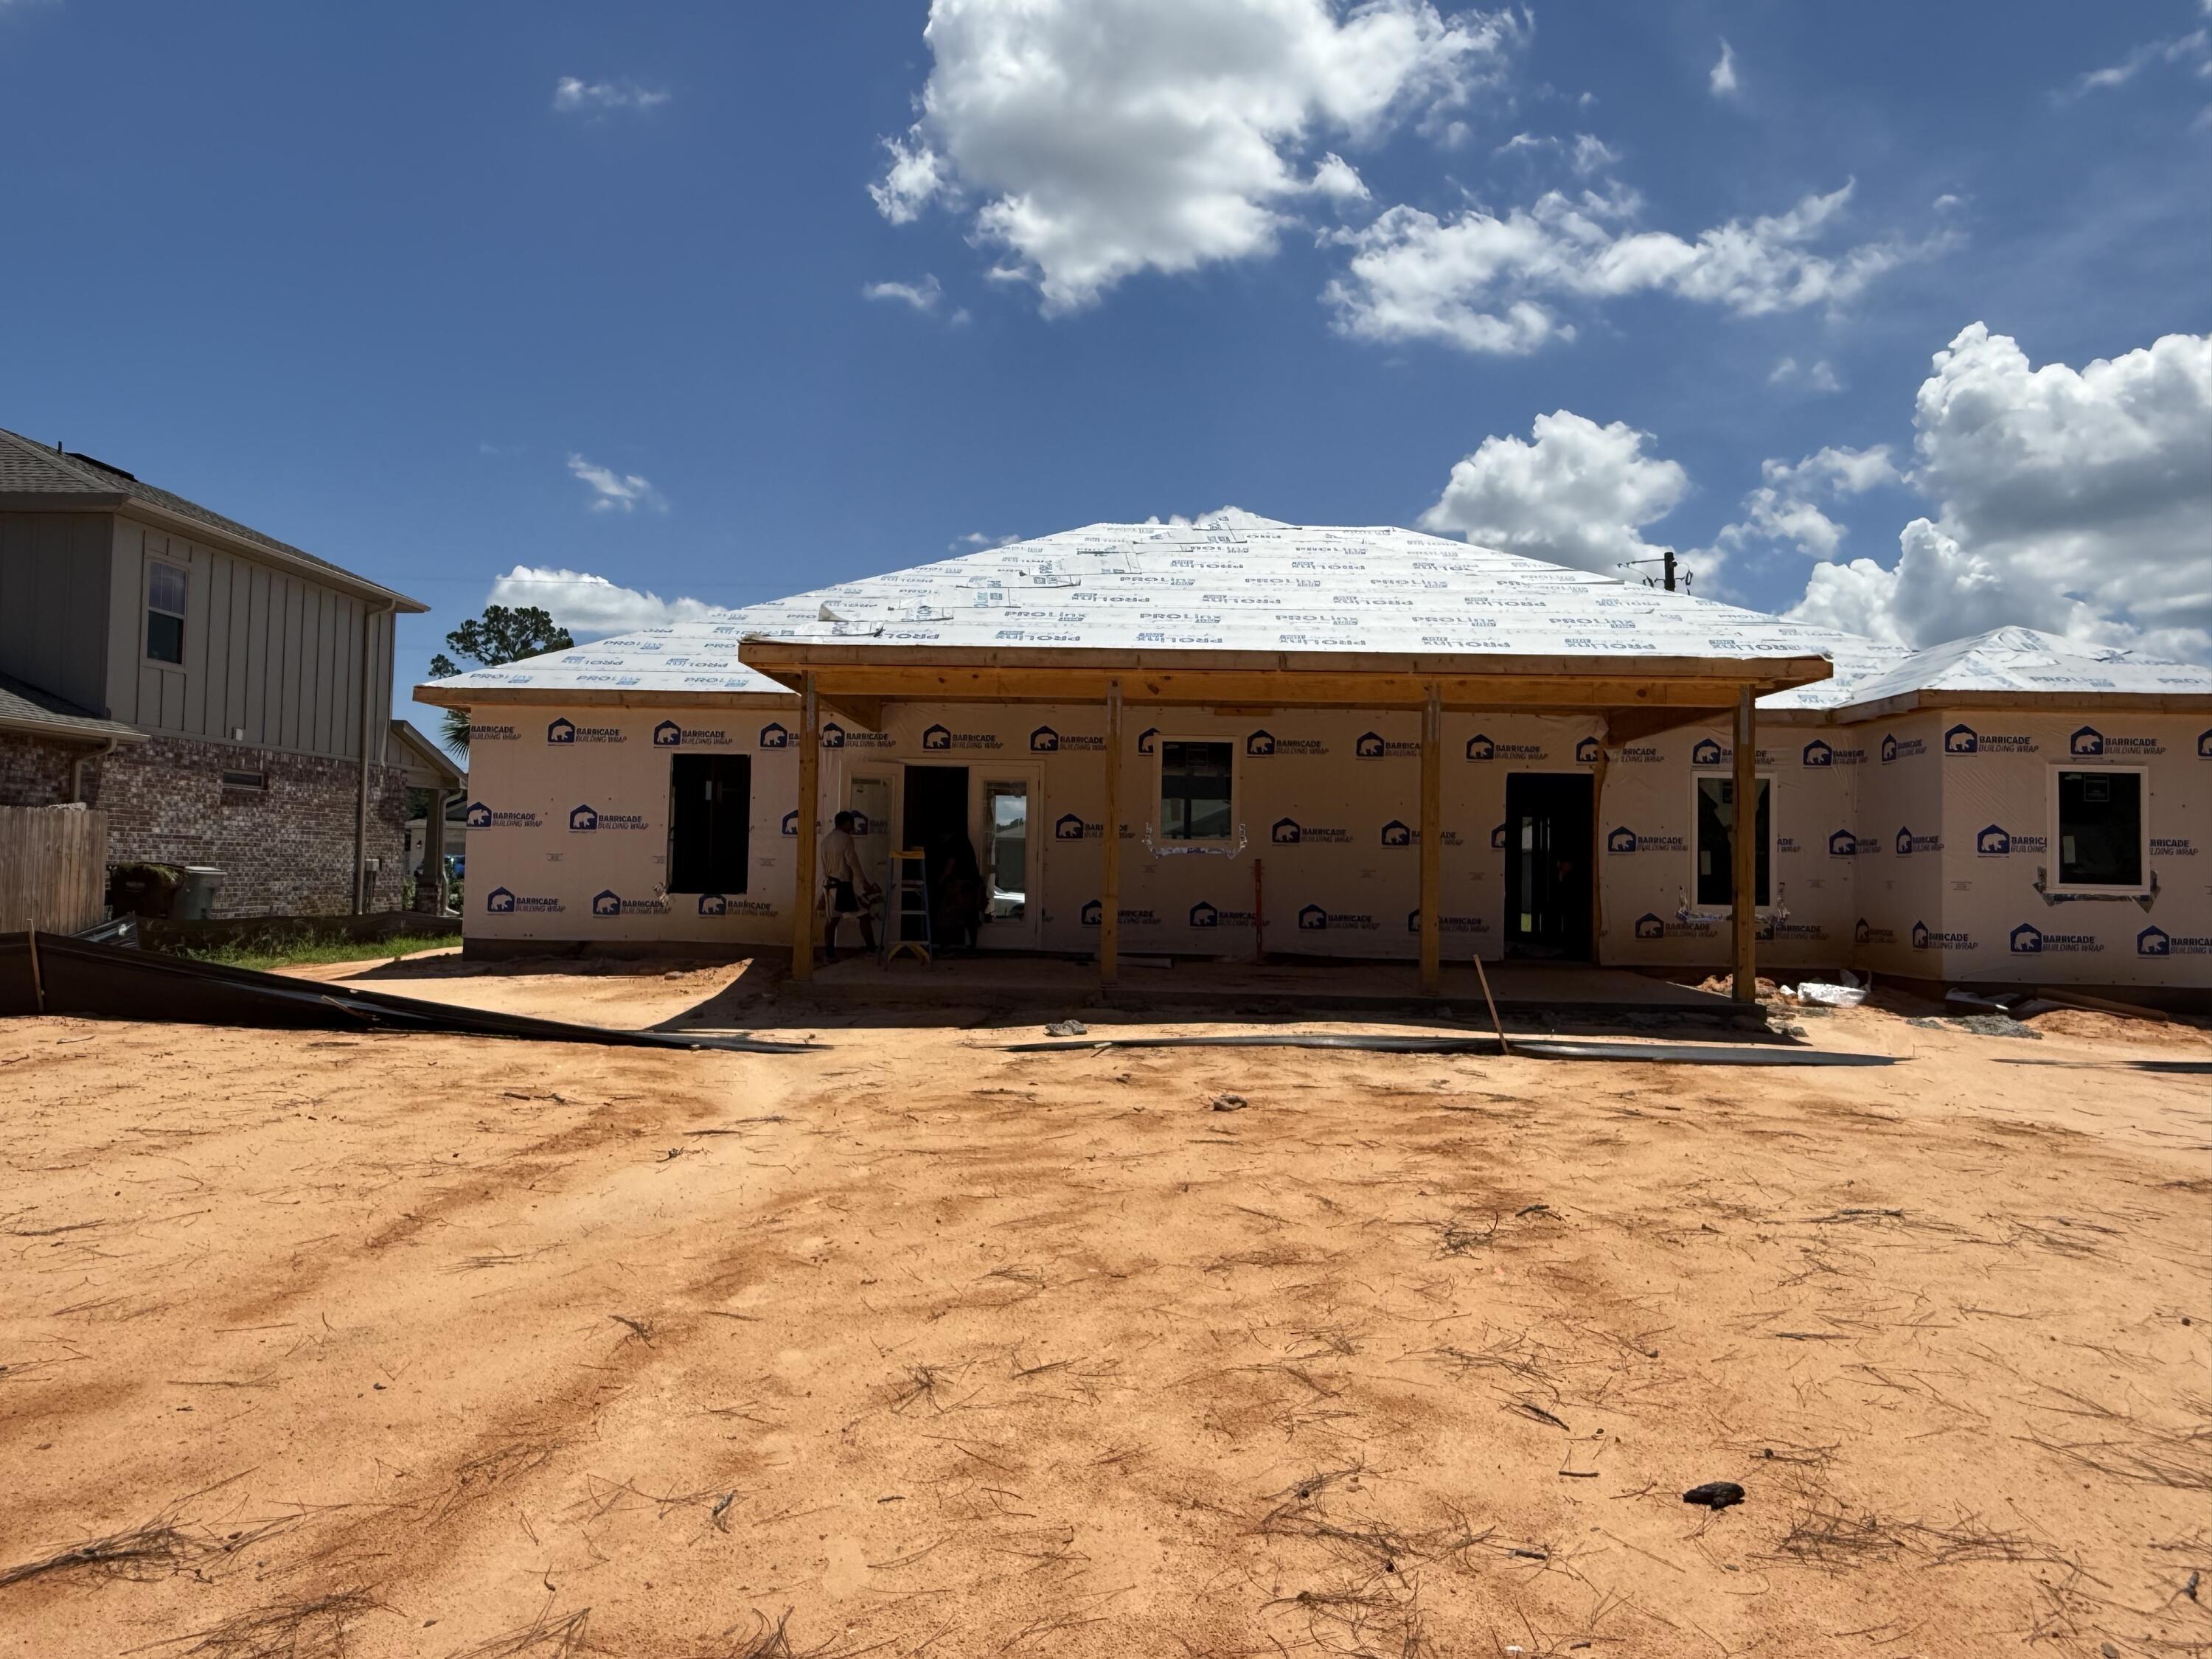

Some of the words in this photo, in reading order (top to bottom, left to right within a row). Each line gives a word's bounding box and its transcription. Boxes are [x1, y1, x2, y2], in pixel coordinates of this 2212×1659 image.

[1979, 736, 2031, 745] BARRICADE
[2105, 738, 2157, 747] BARRICADE
[1978, 744, 2014, 753] BUILDING
[2017, 745, 2039, 754] WRAP
[2104, 746, 2142, 755] BUILDING
[2143, 747, 2166, 756] WRAP
[1638, 836, 1683, 844] BARRICADE
[2011, 836, 2047, 845] BARRIC
[2150, 839, 2189, 847] RRICADE
[2042, 935, 2095, 944] BARRICADE
[2042, 943, 2080, 952] BUILDING
[2081, 944, 2104, 953] WRAP
[2170, 946, 2205, 955] BUILDING
